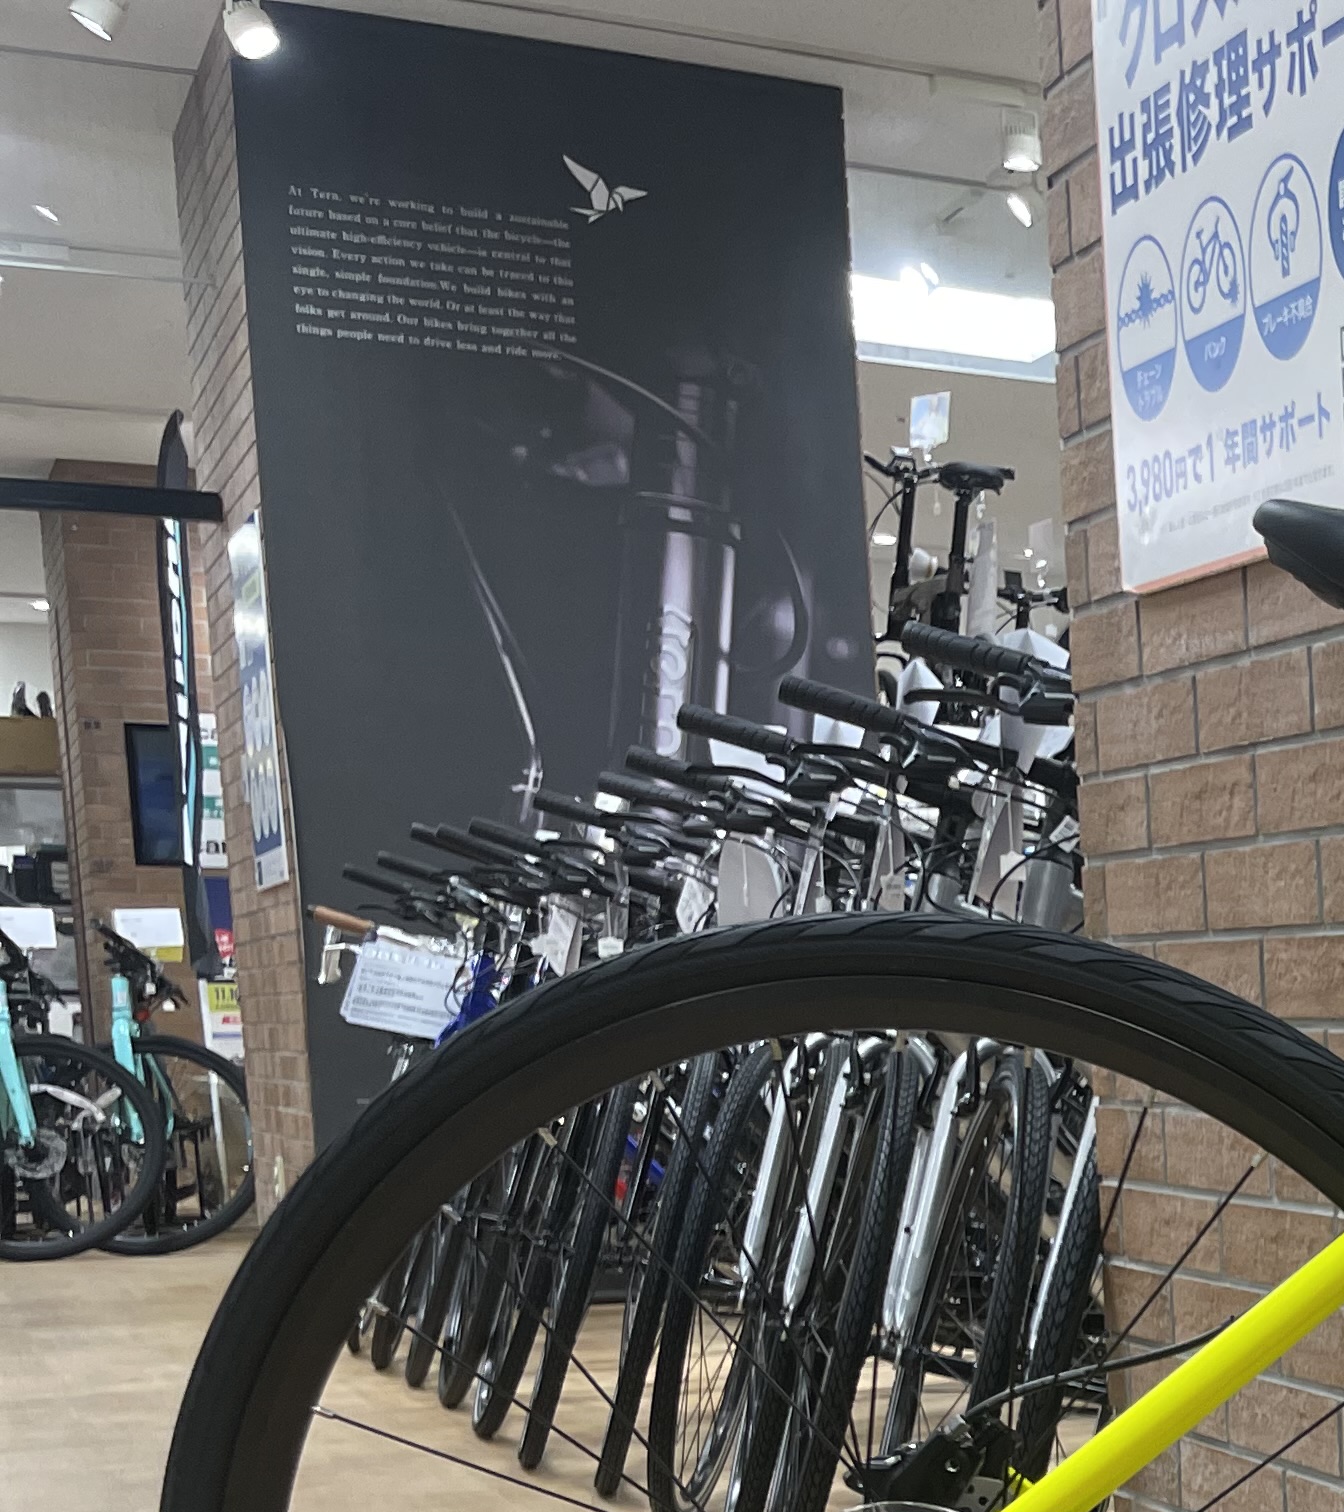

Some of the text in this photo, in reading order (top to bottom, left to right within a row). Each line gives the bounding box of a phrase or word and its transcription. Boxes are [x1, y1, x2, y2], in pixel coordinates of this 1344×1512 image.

[289, 204, 325, 219] future
[328, 209, 361, 223] based
[393, 219, 418, 229] core
[421, 220, 452, 234] belief
[456, 224, 478, 237] that
[388, 199, 435, 214] working
[460, 207, 488, 219] build
[290, 226, 338, 240] ultimate
[491, 250, 531, 262] central
[550, 257, 571, 268] that
[332, 247, 367, 264] Every
[371, 254, 405, 267] action
[430, 261, 454, 273] take
[554, 275, 574, 287] this
[335, 269, 372, 284] simple
[463, 283, 491, 296] build
[497, 287, 527, 300] bikes
[531, 292, 556, 303] with
[295, 303, 322, 316] folks
[350, 311, 393, 323] around.
[424, 316, 453, 330] bikes
[457, 320, 488, 335] bring
[491, 326, 539, 339] together
[332, 288, 384, 304] changing
[408, 298, 443, 310] world.
[478, 303, 504, 316] least
[554, 312, 575, 324] that
[296, 322, 333, 337] things
[337, 329, 373, 341] people
[378, 332, 404, 344] need
[424, 335, 452, 349] drive
[456, 340, 477, 352] less
[506, 345, 528, 356] ride
